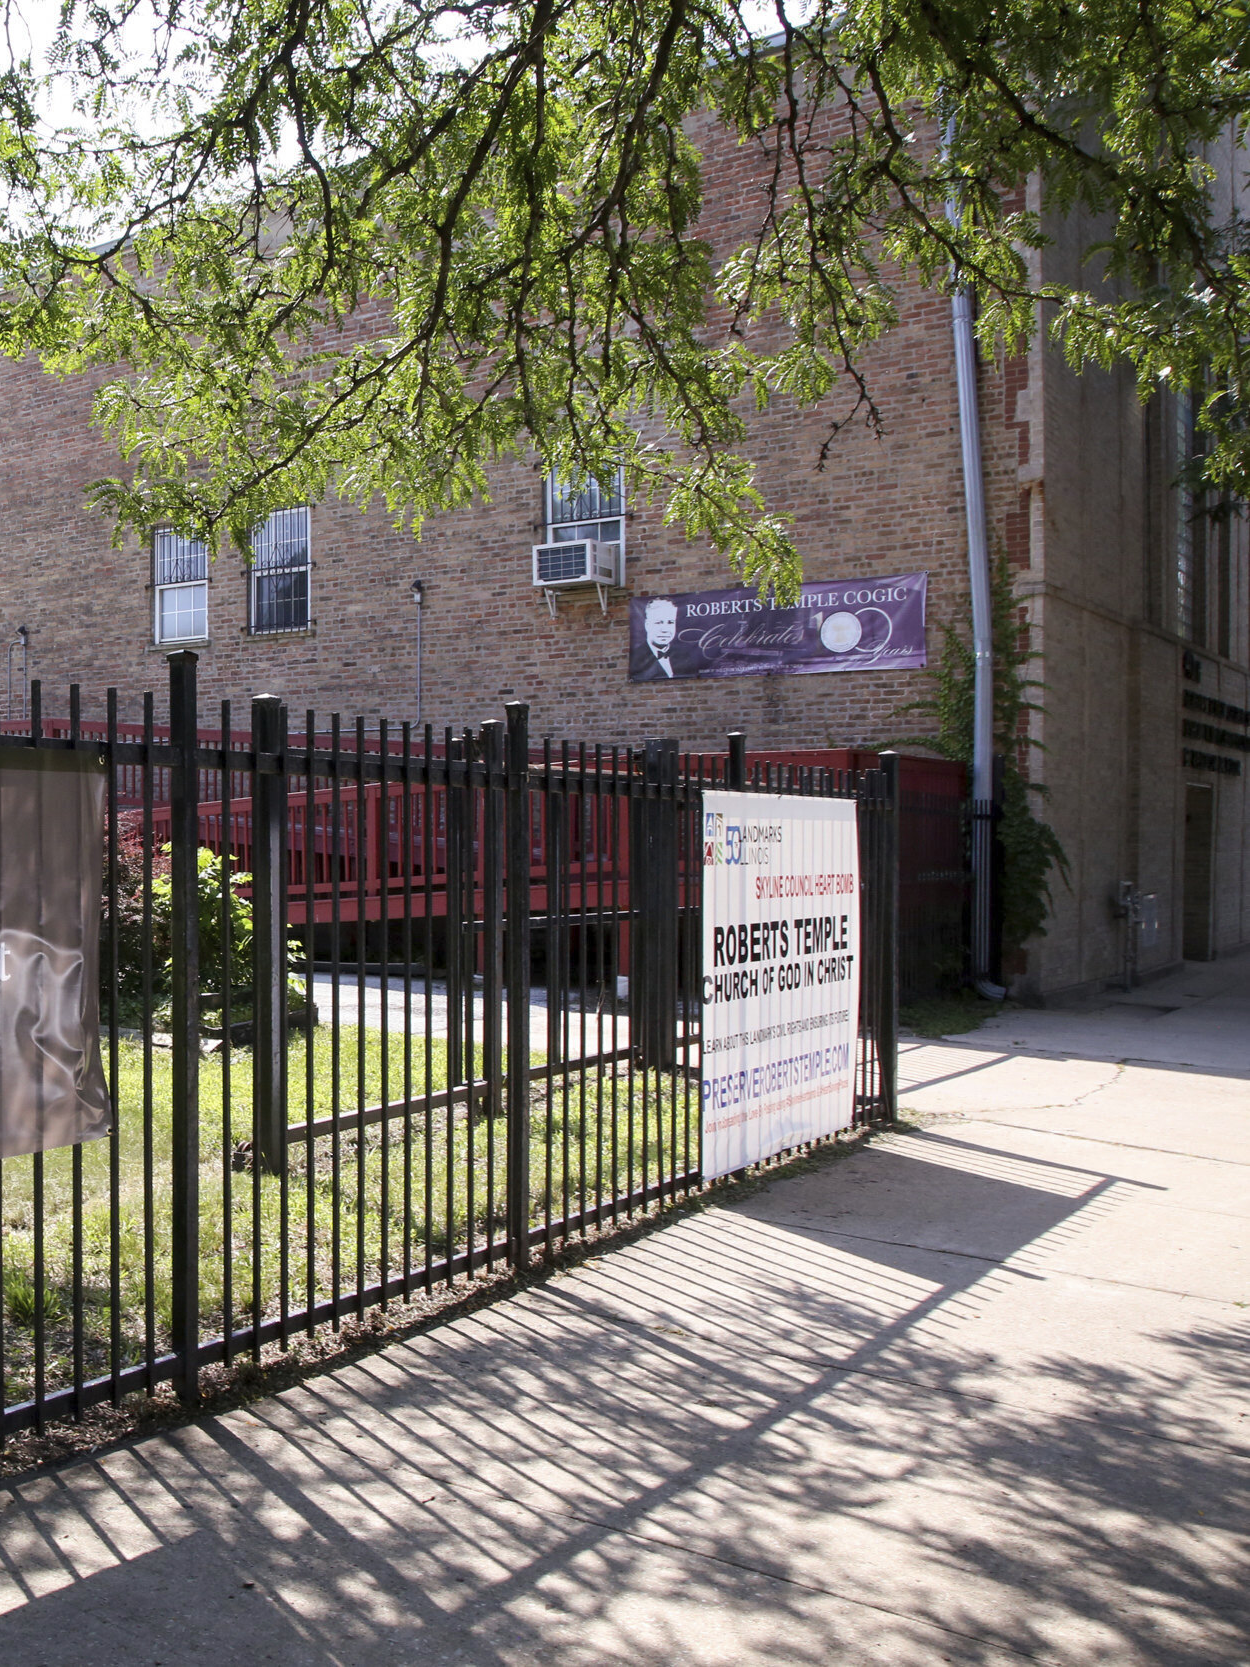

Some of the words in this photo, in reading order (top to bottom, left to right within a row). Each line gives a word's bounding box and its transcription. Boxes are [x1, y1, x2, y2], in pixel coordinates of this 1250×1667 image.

[686, 599, 762, 617] ROBERTS
[767, 592, 839, 611] TMPLE
[843, 587, 907, 605] COGIC
[677, 623, 805, 660] Celebrates
[739, 825, 782, 843] LANDMARKS
[739, 847, 769, 866] LLINOIS
[755, 875, 784, 900] SKYLINE
[785, 874, 814, 898] COUNCIL
[815, 873, 835, 896] HEART
[836, 873, 854, 895] BOMB
[714, 920, 789, 968] ROBERTS
[794, 914, 848, 956] TEMPLE
[703, 969, 759, 1005] CHURCH
[762, 966, 775, 995] OF
[778, 962, 801, 992] GOD
[804, 960, 815, 988] IN
[817, 955, 854, 985] CHRIST
[703, 1039, 724, 1055] LEARN
[724, 1034, 739, 1051] ABOUT
[703, 1042, 849, 1113] PRESERVEROBERTSTEMPLE.COM
